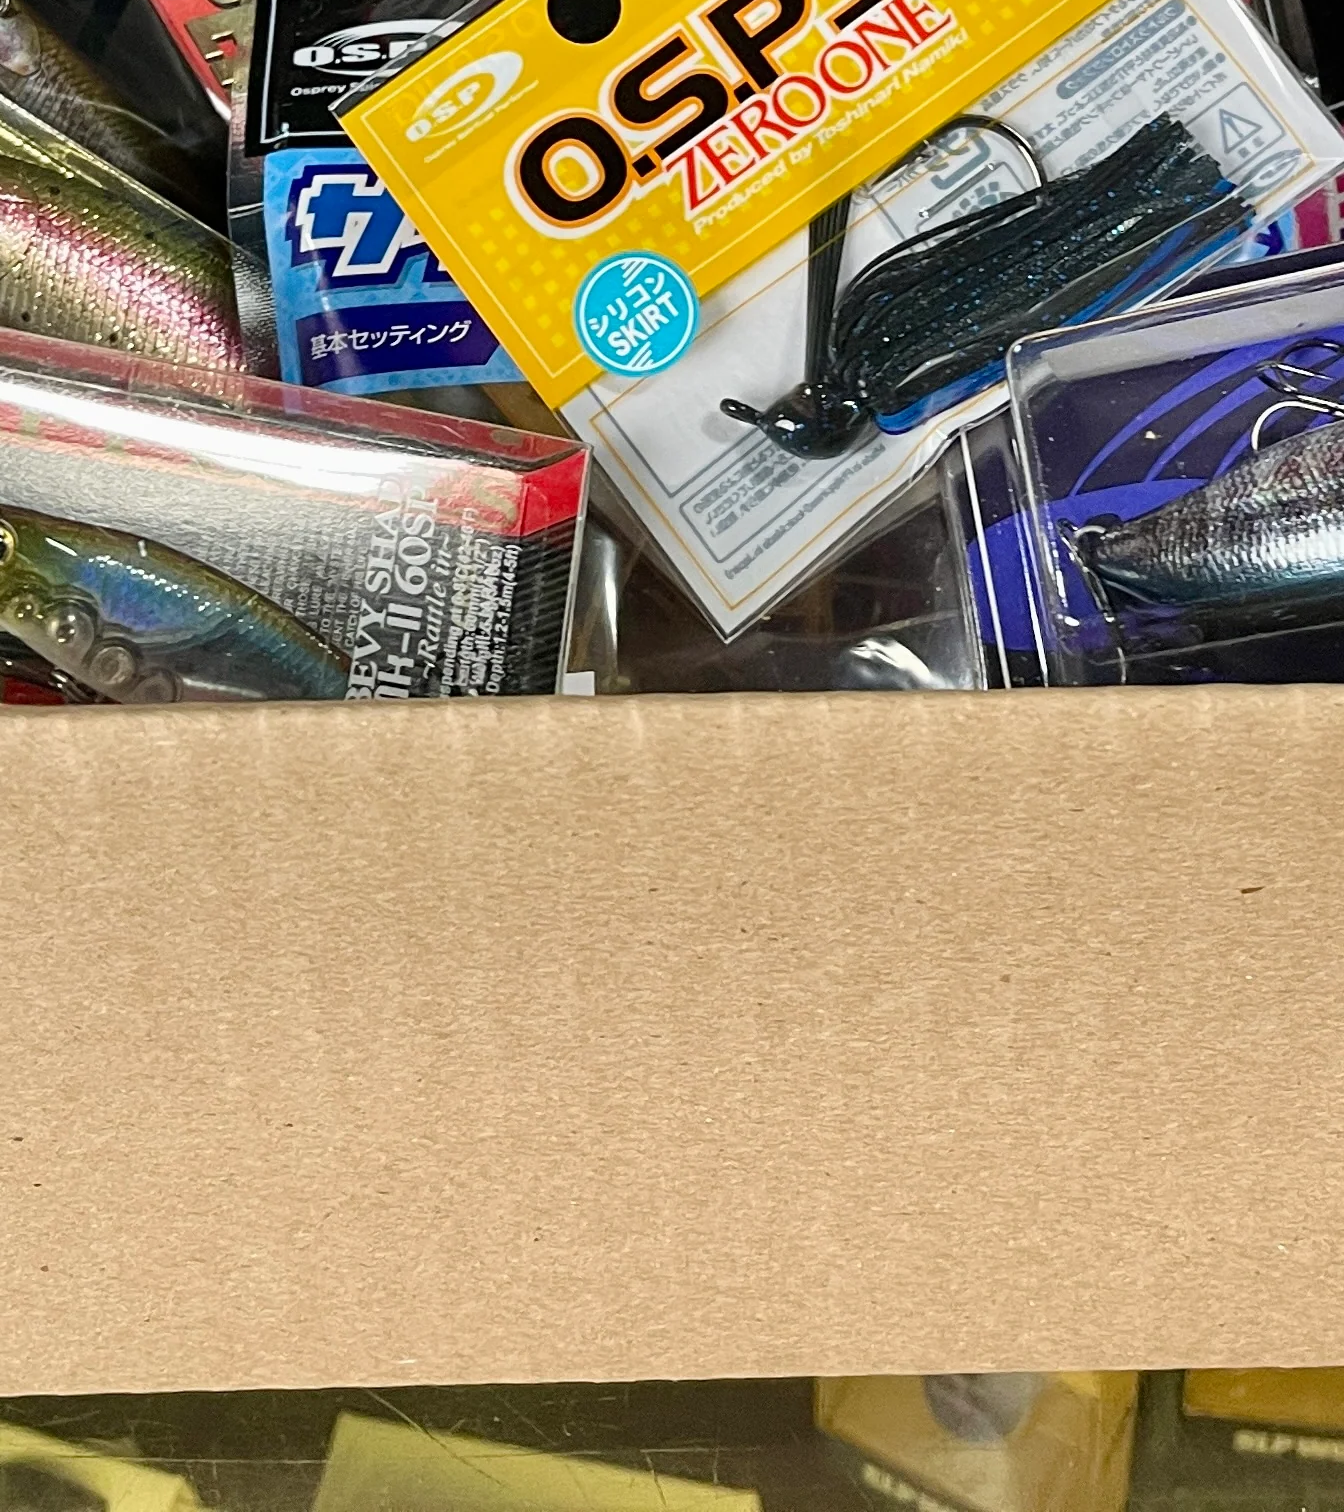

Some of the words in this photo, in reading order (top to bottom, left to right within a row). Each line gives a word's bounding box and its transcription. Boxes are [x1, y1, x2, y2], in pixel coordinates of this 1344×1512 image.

[290, 82, 348, 98] Osprey
[693, 159, 787, 236] Produced
[788, 141, 815, 166] by
[813, 78, 902, 147] Toshinari
[902, 27, 969, 84] Namiki
[587, 267, 668, 339] シリコン
[606, 290, 682, 358] SKIRT
[309, 318, 473, 362] 基本セッティング
